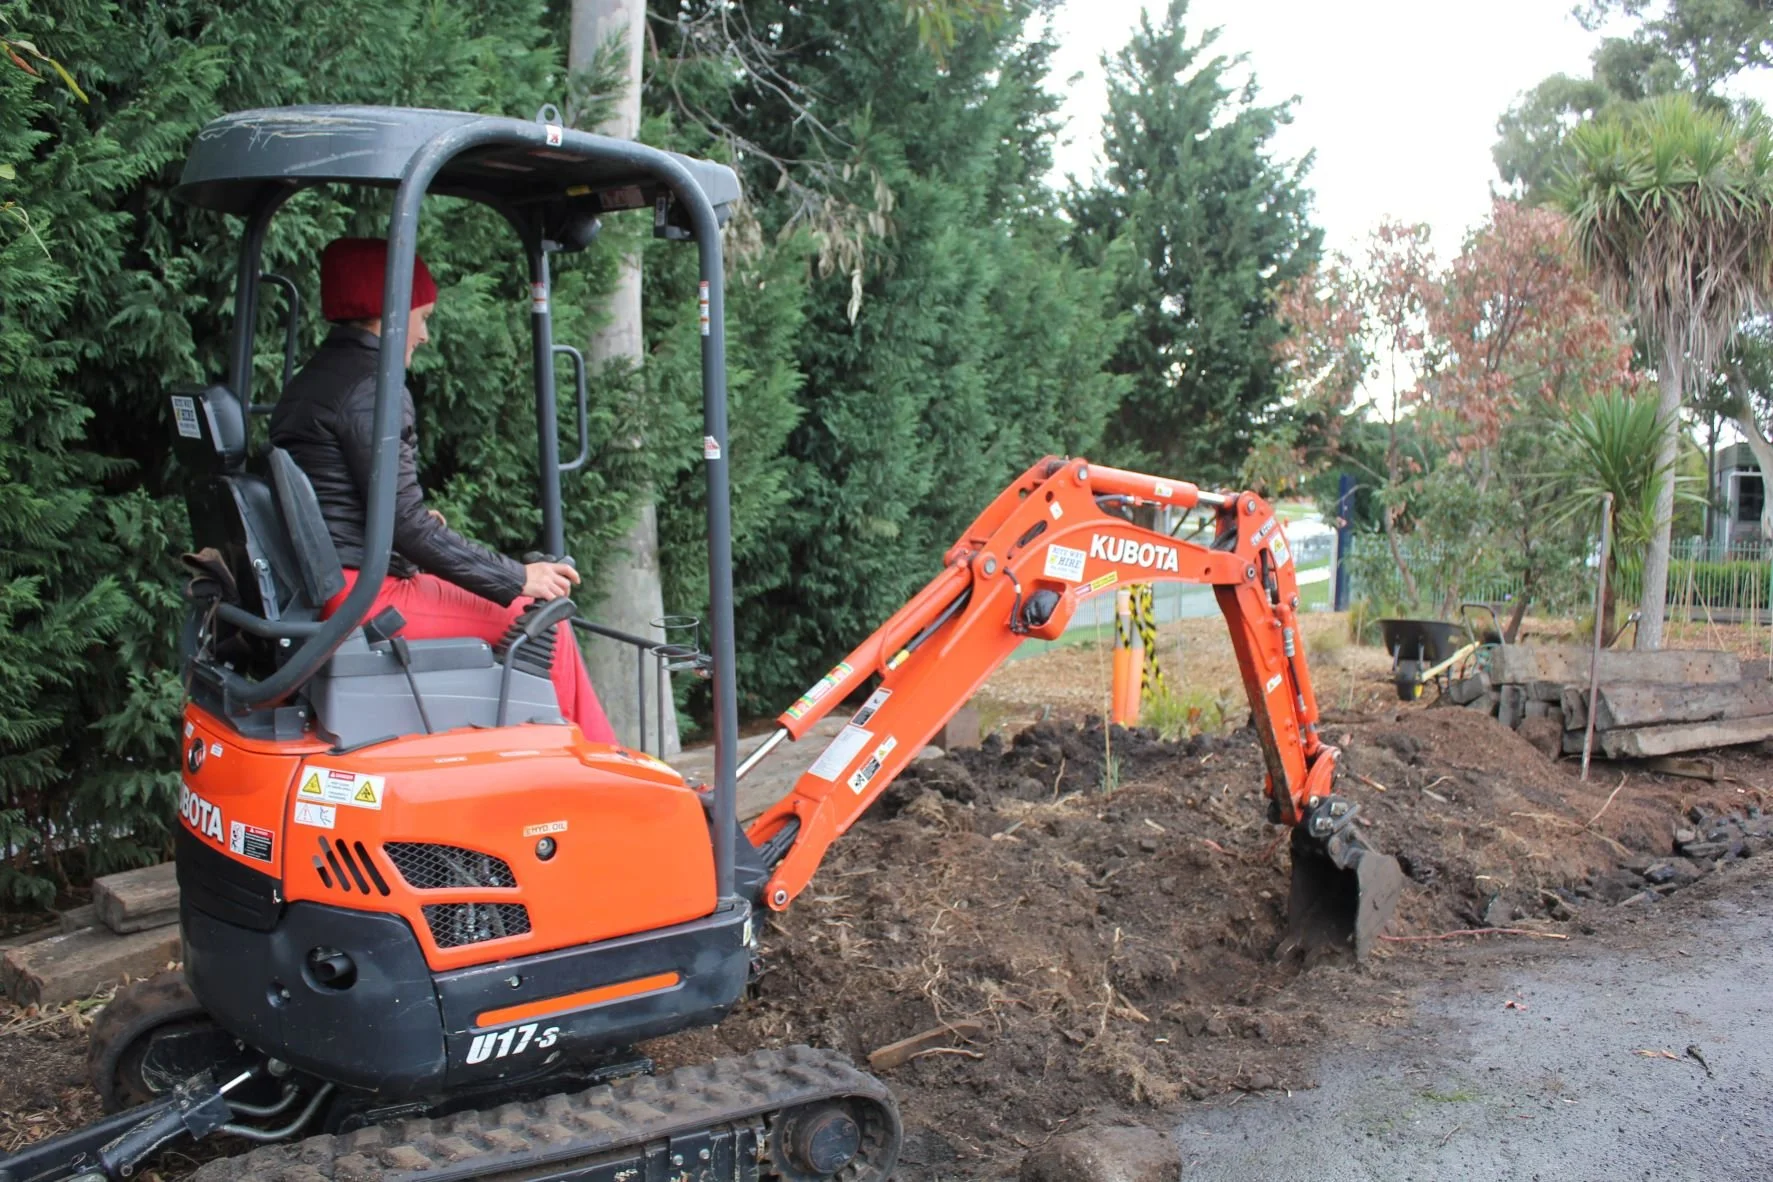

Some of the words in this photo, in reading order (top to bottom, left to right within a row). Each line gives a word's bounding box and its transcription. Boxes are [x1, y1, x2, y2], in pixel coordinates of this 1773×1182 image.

[1058, 556, 1082, 569] HIRE
[1090, 533, 1179, 572] KUBOTA
[180, 783, 224, 843] BOTA
[552, 823, 566, 831] OIL
